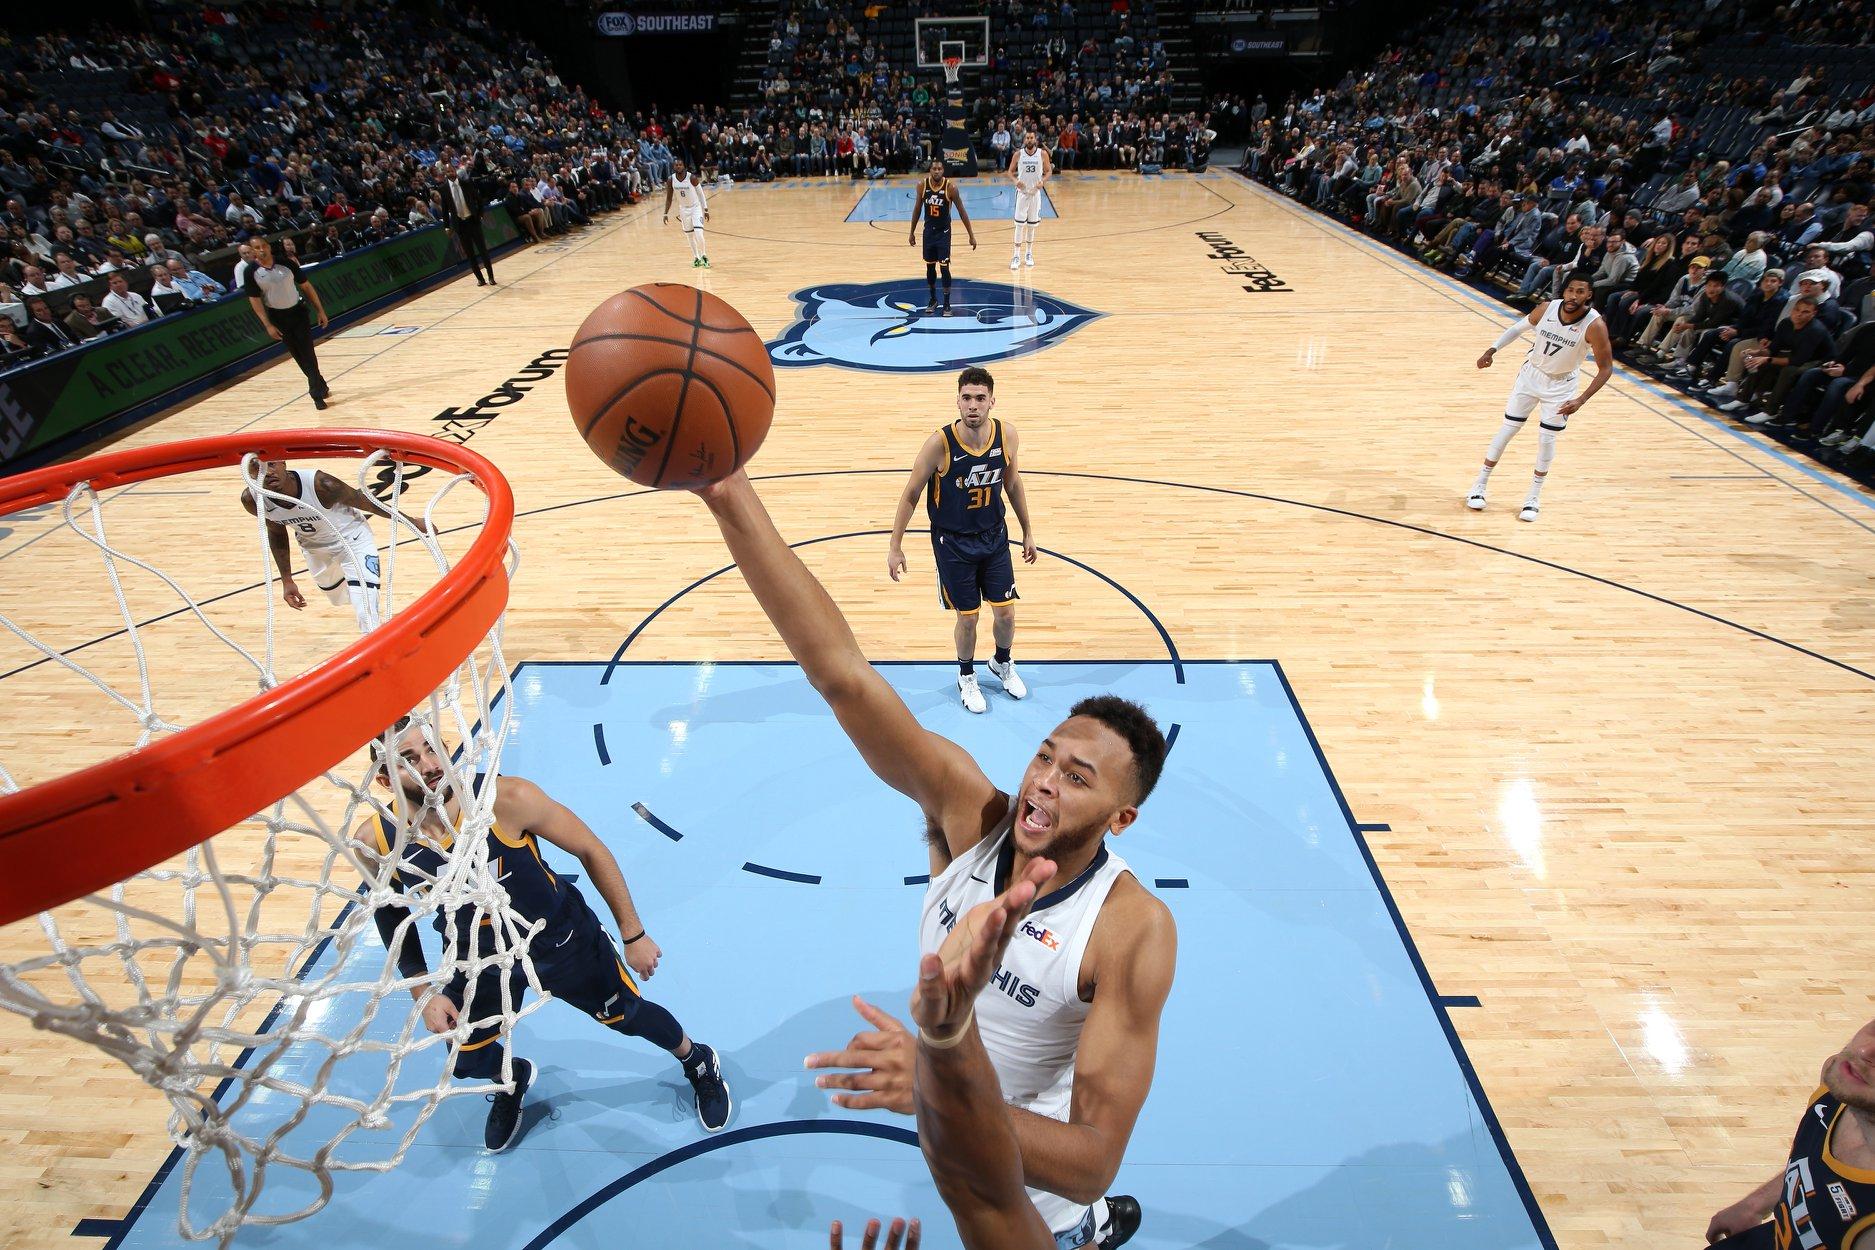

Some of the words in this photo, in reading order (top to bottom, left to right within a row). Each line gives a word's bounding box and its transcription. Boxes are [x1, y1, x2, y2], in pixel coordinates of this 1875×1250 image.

[605, 17, 626, 27] FOX
[637, 15, 714, 31] SOUTHEAST
[1247, 40, 1284, 49] SOUTHEAST
[944, 150, 967, 158] SONIC
[1025, 165, 1036, 173] 33
[930, 205, 940, 217] 15
[1540, 330, 1576, 347] MEMPHIS
[1543, 341, 1562, 356] 17
[86, 371, 114, 399] A
[104, 343, 188, 389] CLEAR,
[956, 464, 1002, 487] JAZZ
[967, 487, 992, 509] 31
[298, 522, 317, 533] 8
[1020, 921, 1059, 951] FedEx
[1830, 1185, 1844, 1194] 5
[1835, 1197, 1849, 1218] FIGHT
